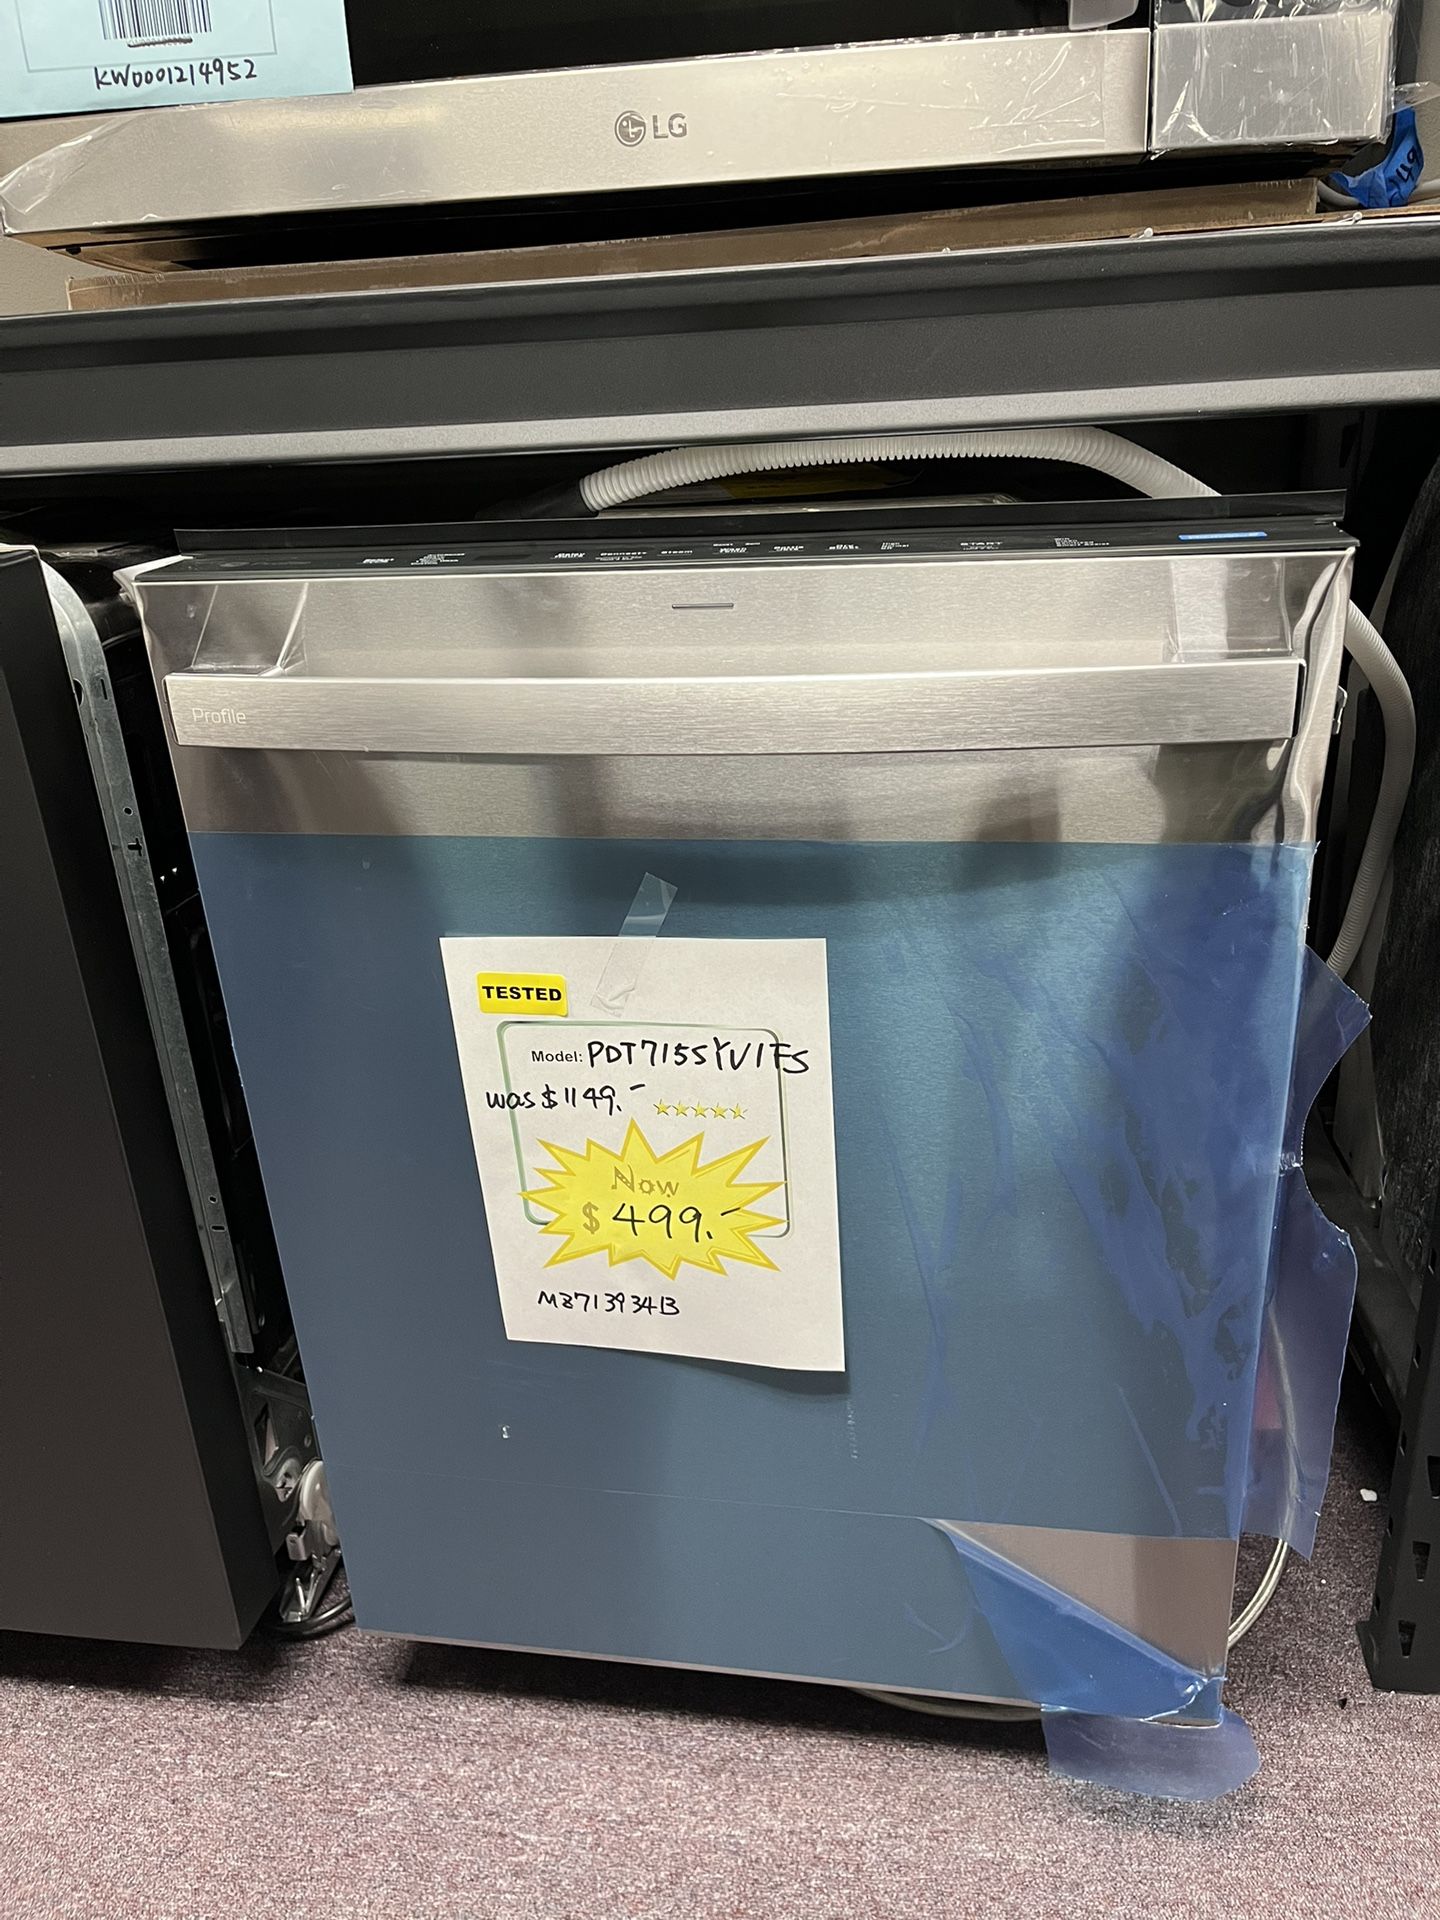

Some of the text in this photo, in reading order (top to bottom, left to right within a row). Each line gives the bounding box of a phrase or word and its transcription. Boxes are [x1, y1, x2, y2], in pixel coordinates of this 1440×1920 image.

[94, 58, 257, 90] KW0001214952
[652, 112, 688, 139] LG
[192, 707, 247, 724] Profile
[482, 985, 562, 1002] TESTED
[531, 1050, 583, 1063] Model:
[486, 1088, 536, 1111] was
[611, 1164, 680, 1198] Now
[582, 1201, 600, 1235] $
